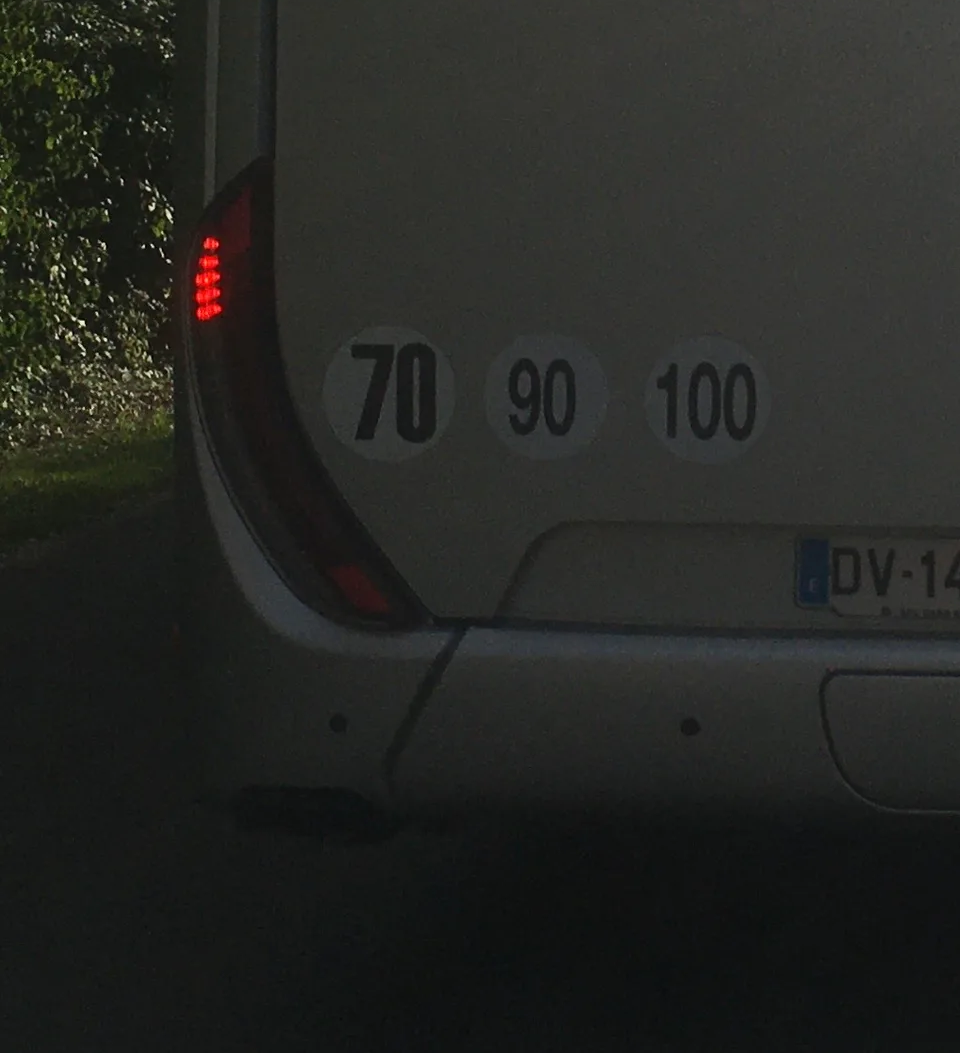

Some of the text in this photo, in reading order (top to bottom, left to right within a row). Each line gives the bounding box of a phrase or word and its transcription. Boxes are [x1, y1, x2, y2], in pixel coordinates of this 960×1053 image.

[351, 342, 437, 444] 70
[509, 357, 576, 436] 90
[657, 361, 757, 442] 100
